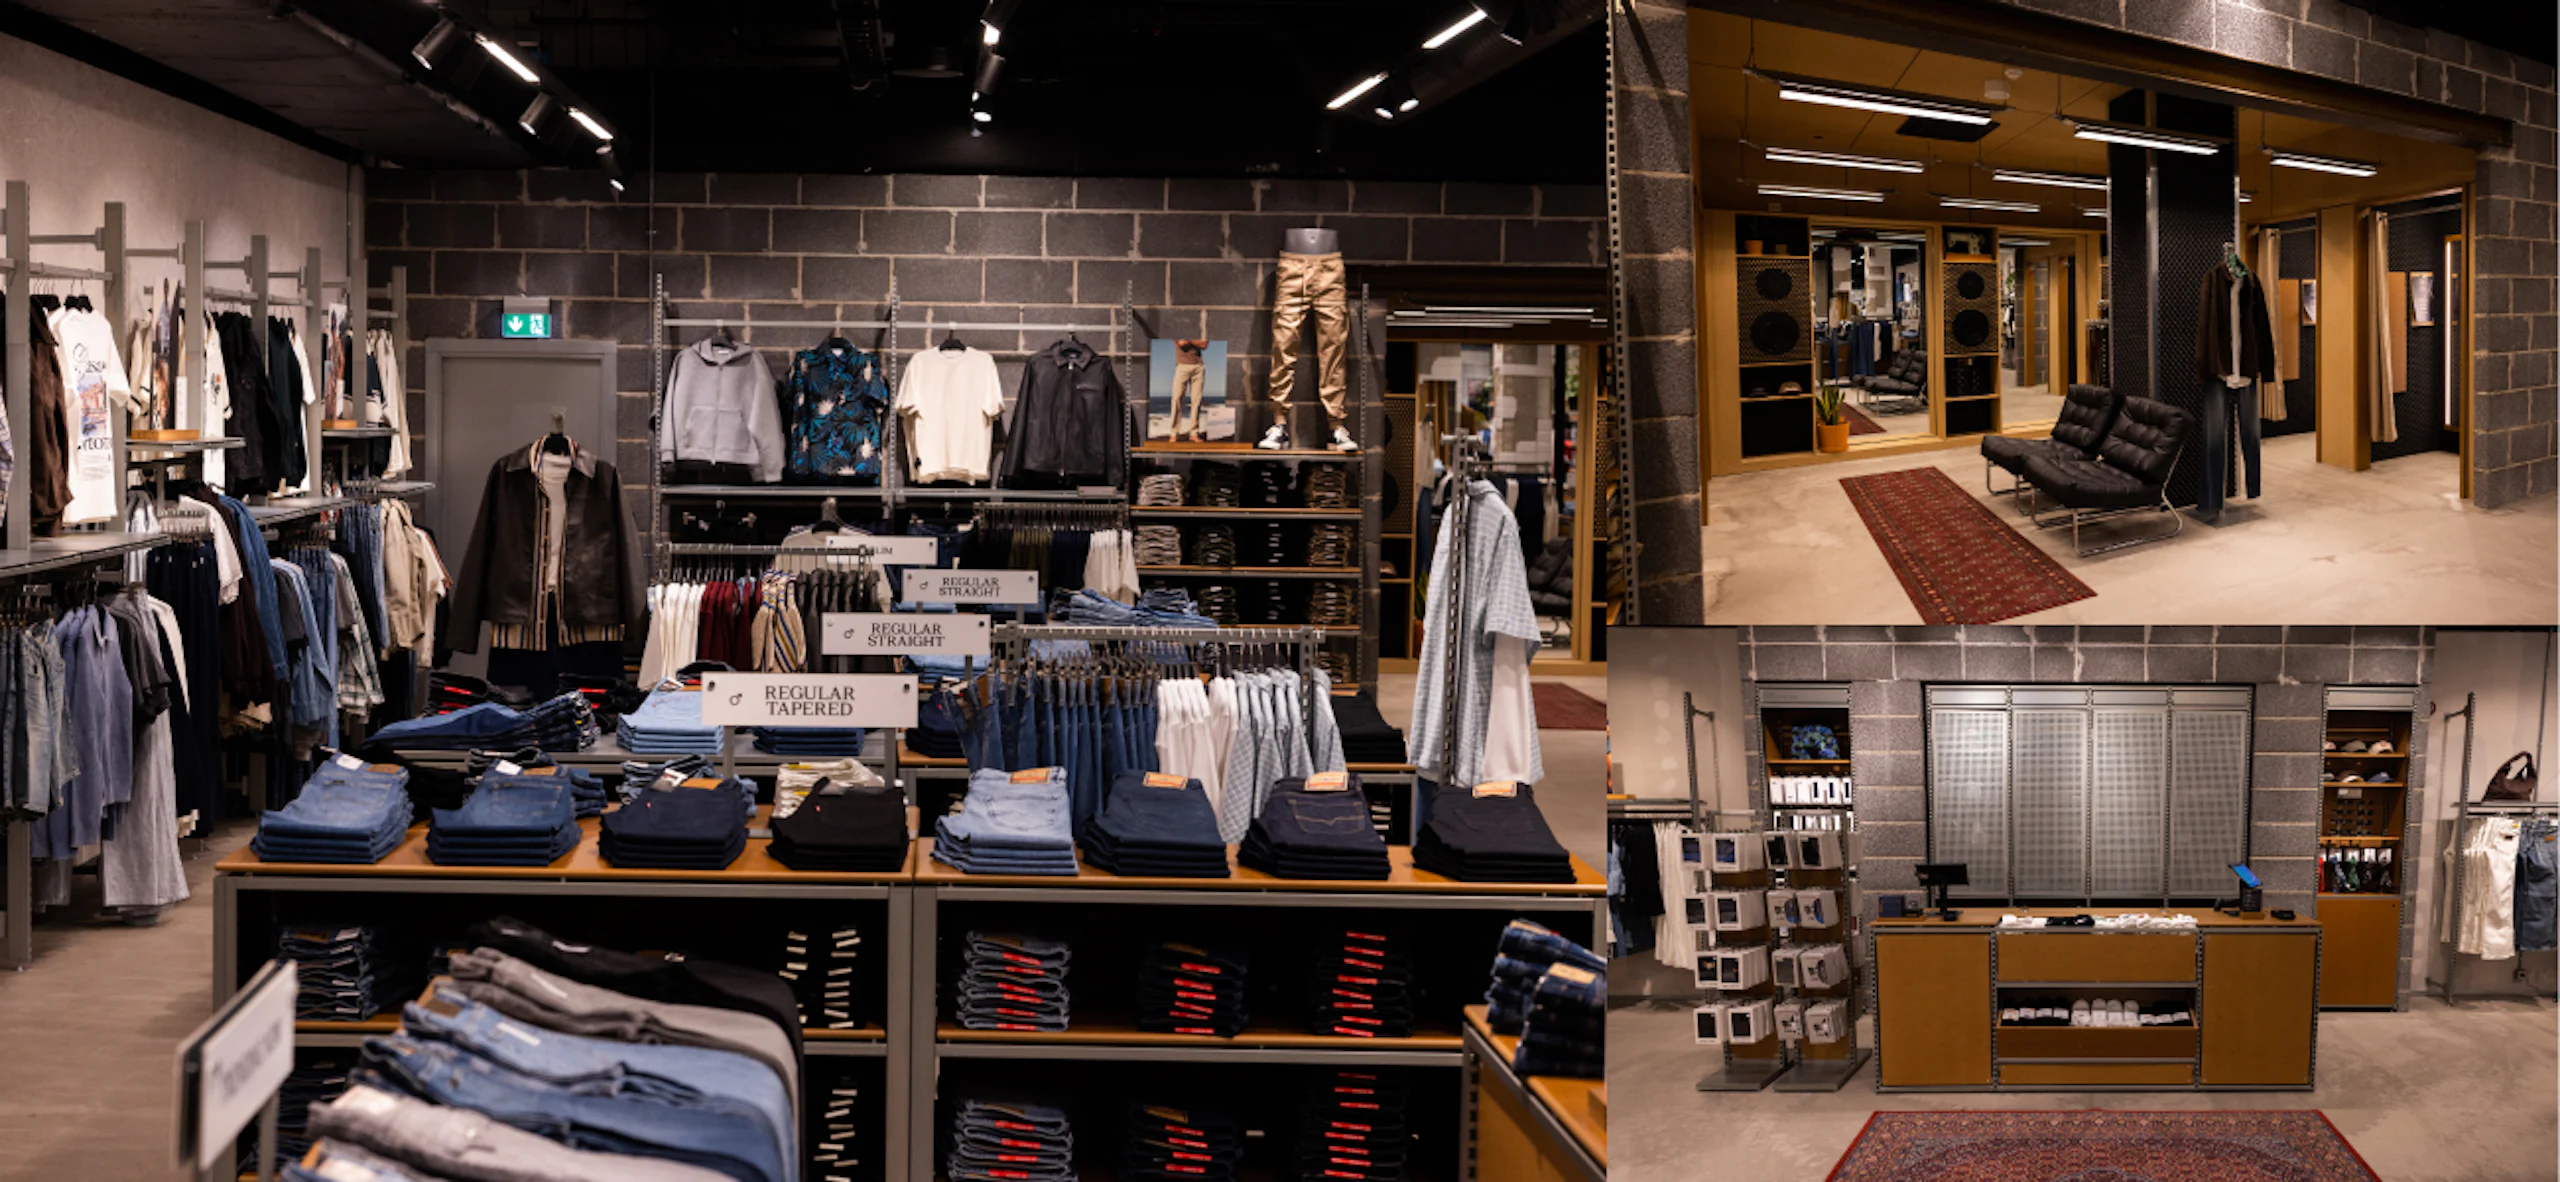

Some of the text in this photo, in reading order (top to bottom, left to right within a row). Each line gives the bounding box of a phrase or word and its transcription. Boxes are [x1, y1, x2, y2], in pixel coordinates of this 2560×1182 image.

[942, 577, 999, 587] REGULAR
[939, 586, 1001, 598] STRAIGHT
[871, 622, 943, 635] REGULAR
[868, 635, 945, 647] STRAIGHT
[765, 685, 856, 700] REGULAR
[766, 701, 853, 716] TAPERED
